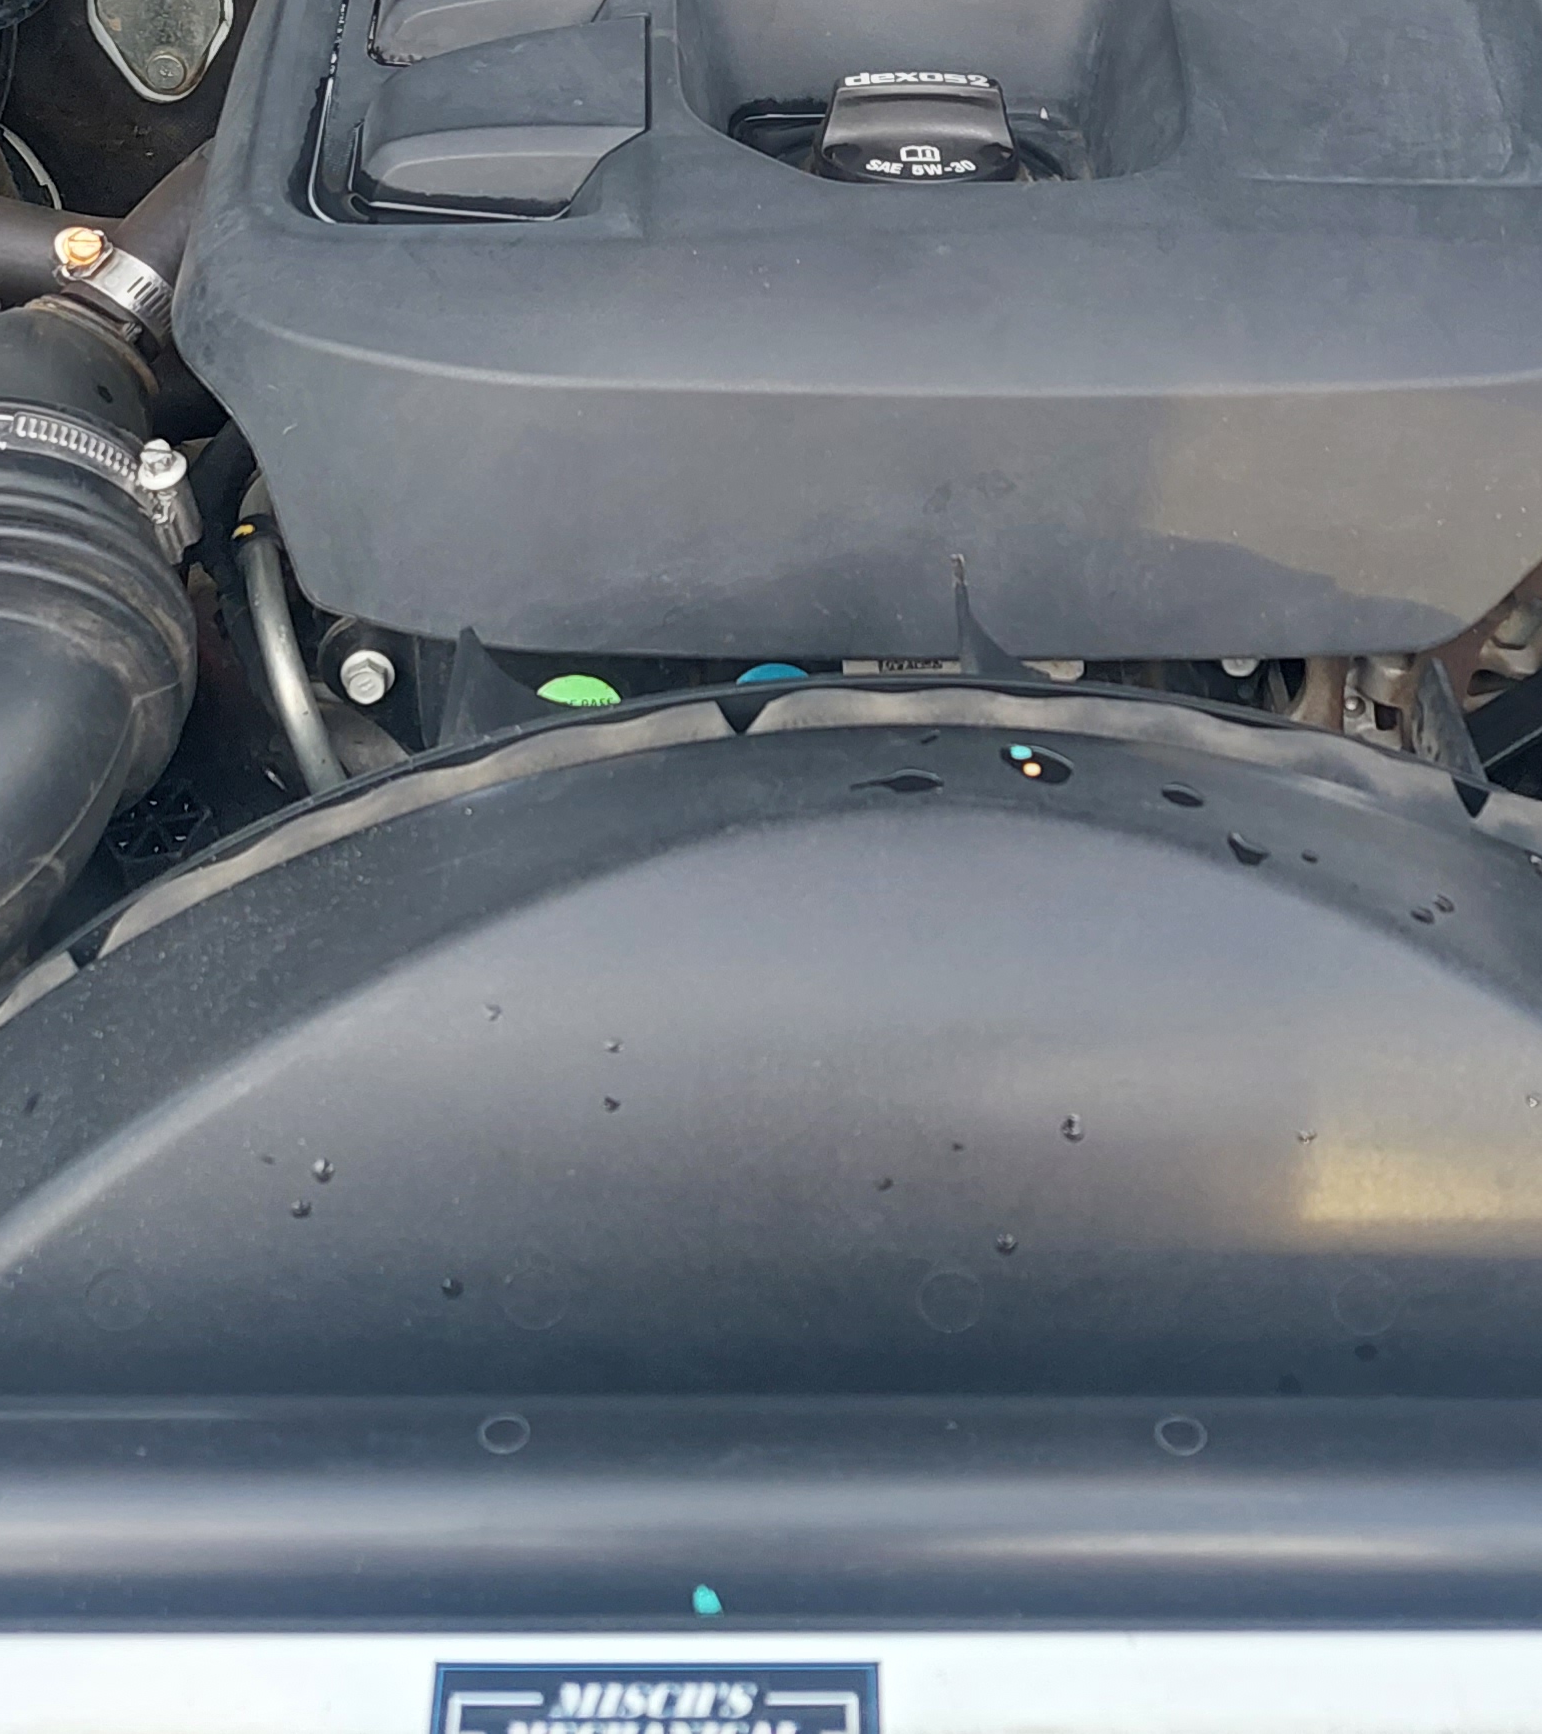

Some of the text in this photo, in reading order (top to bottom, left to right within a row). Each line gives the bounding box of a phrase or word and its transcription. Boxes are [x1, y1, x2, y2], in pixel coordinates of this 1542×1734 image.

[844, 71, 990, 89] dexos2
[865, 158, 977, 176] SAE 5W-30
